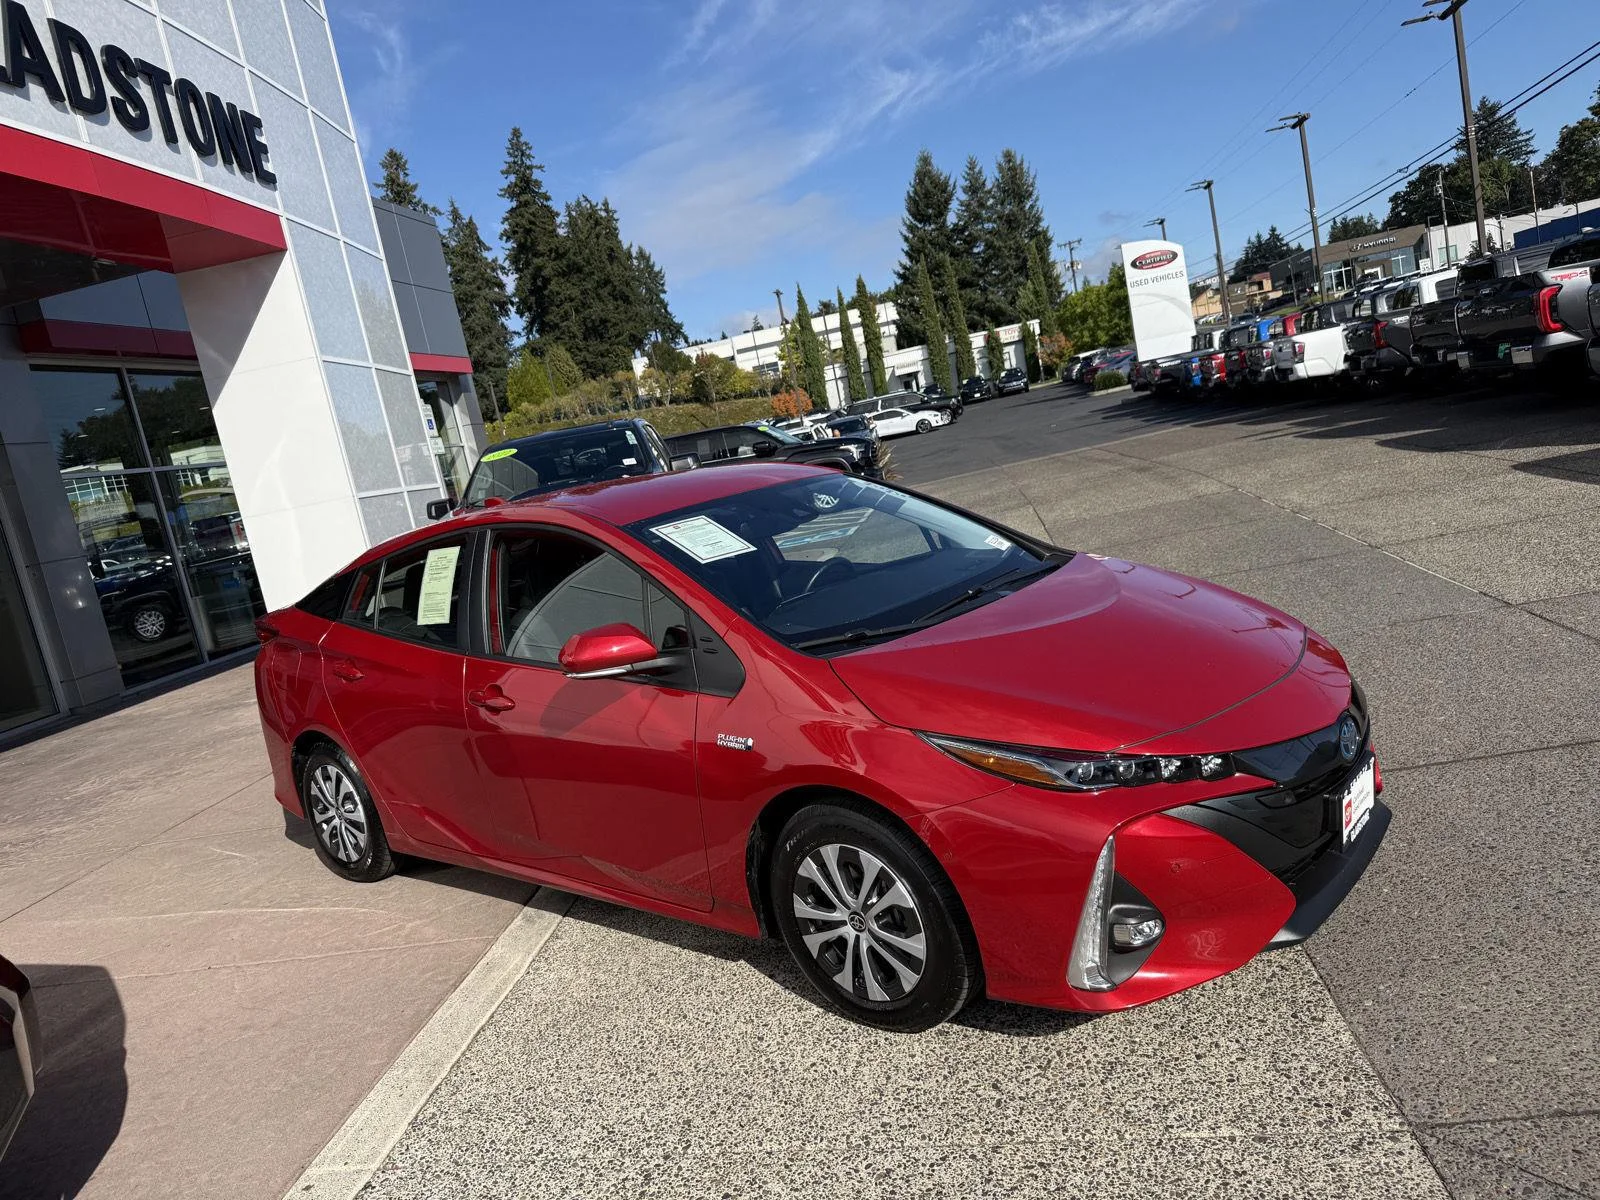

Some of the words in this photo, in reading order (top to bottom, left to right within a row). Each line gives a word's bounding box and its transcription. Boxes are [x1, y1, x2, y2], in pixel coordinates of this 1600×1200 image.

[1129, 278, 1149, 289] USED
[1150, 270, 1184, 283] VEHICLES
[717, 733, 747, 743] PLUG-IN
[717, 739, 746, 750] HYBRID
